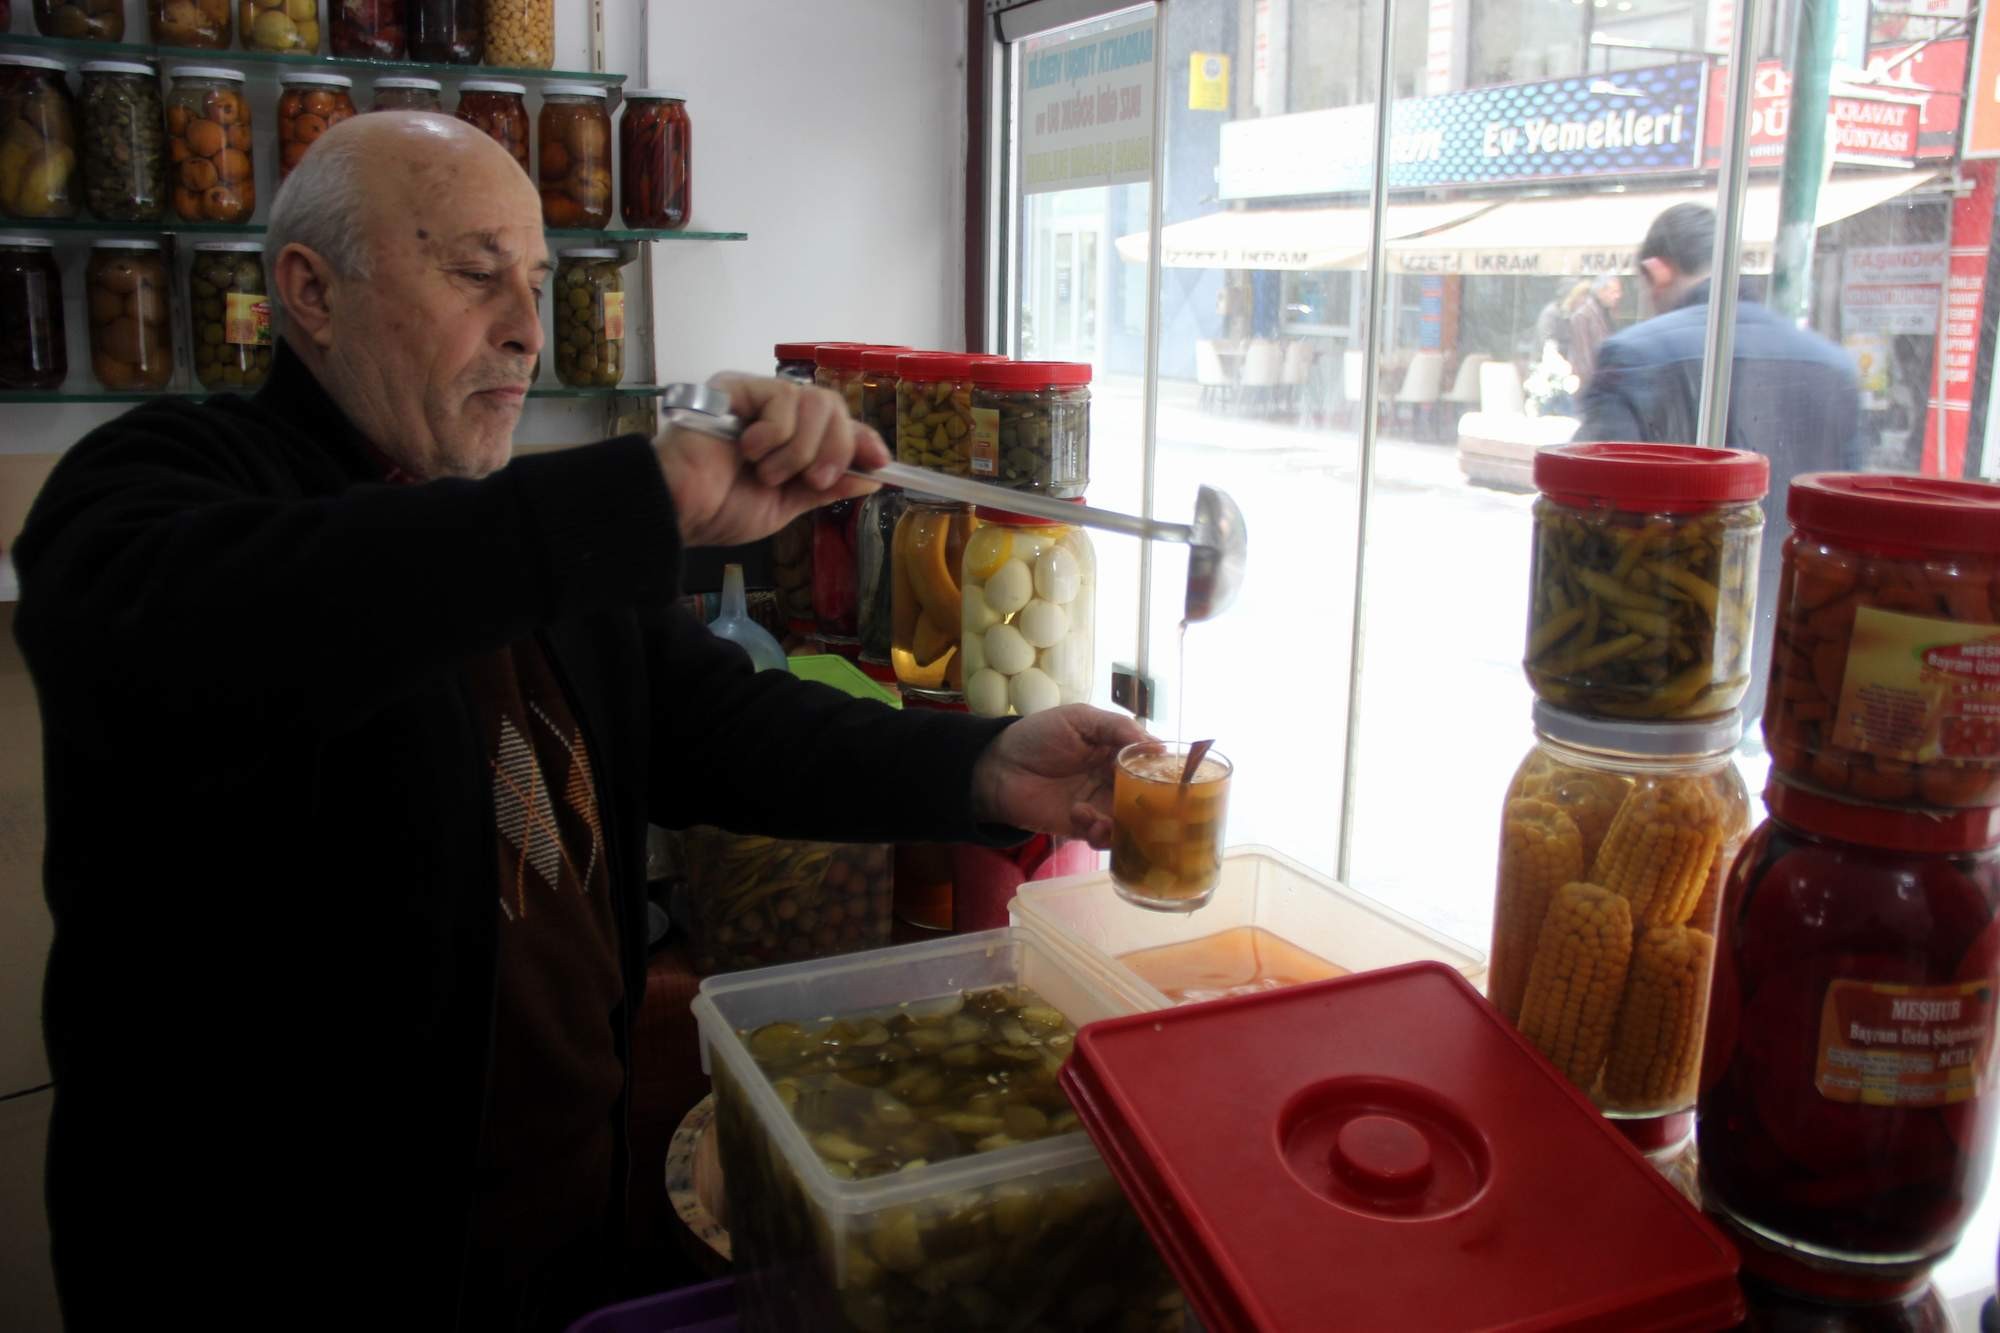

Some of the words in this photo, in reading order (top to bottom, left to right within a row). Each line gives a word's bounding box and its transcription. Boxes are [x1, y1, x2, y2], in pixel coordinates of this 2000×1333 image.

[1834, 101, 1908, 126] KRAVAT
[1482, 123, 1517, 158] Ev
[1523, 104, 1684, 155] Yemekleri
[1475, 252, 1538, 270] İKRAM
[1928, 652, 1973, 673] Bayram
[1892, 999, 1961, 1025] MEŞHUR
[1849, 1020, 1898, 1044] Bayram
[1901, 1027, 1931, 1044] Usta
